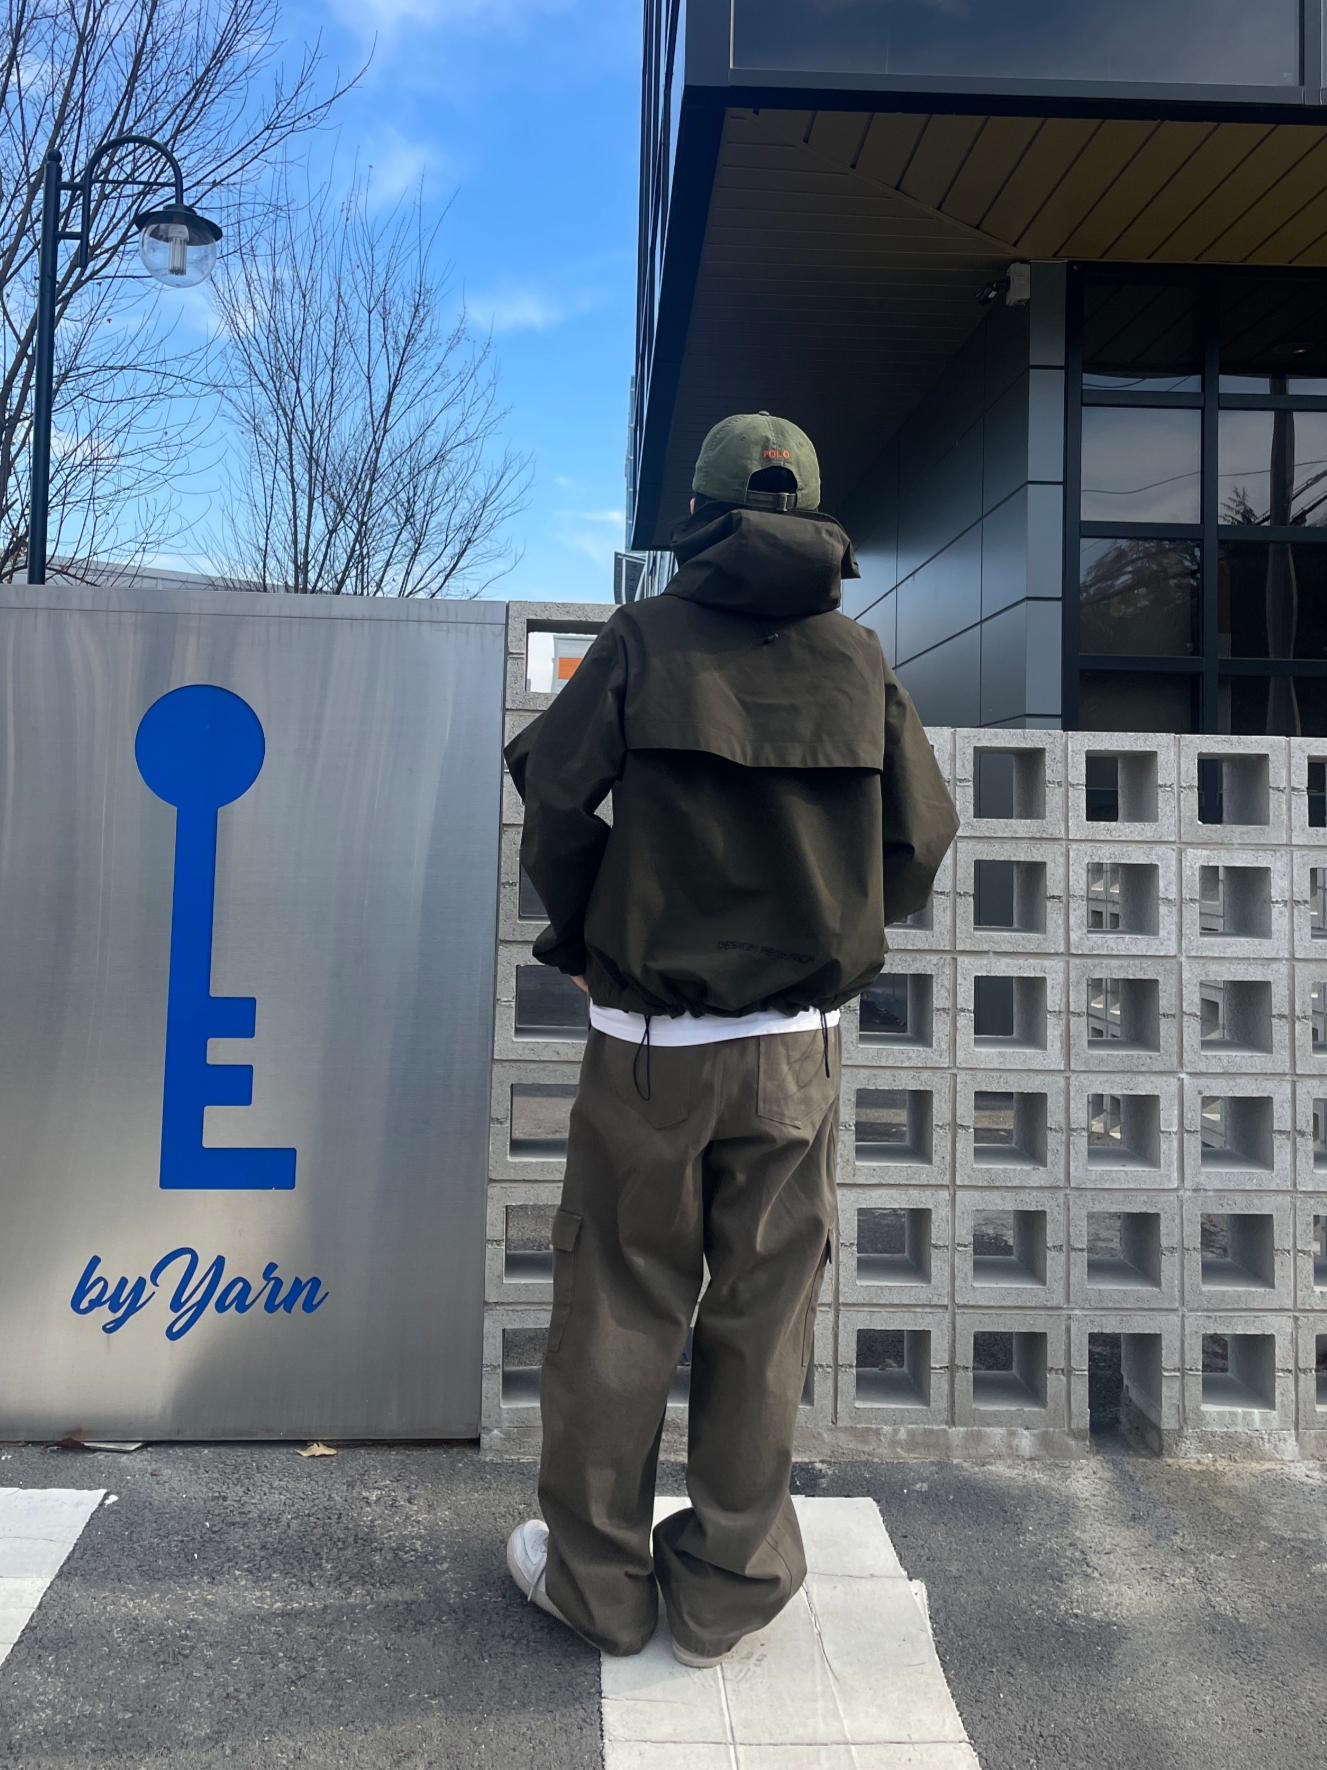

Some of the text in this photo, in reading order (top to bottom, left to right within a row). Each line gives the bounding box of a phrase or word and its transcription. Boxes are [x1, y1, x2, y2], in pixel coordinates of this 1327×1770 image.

[763, 450, 790, 459] POLO
[70, 1247, 329, 1341] by Yarn
